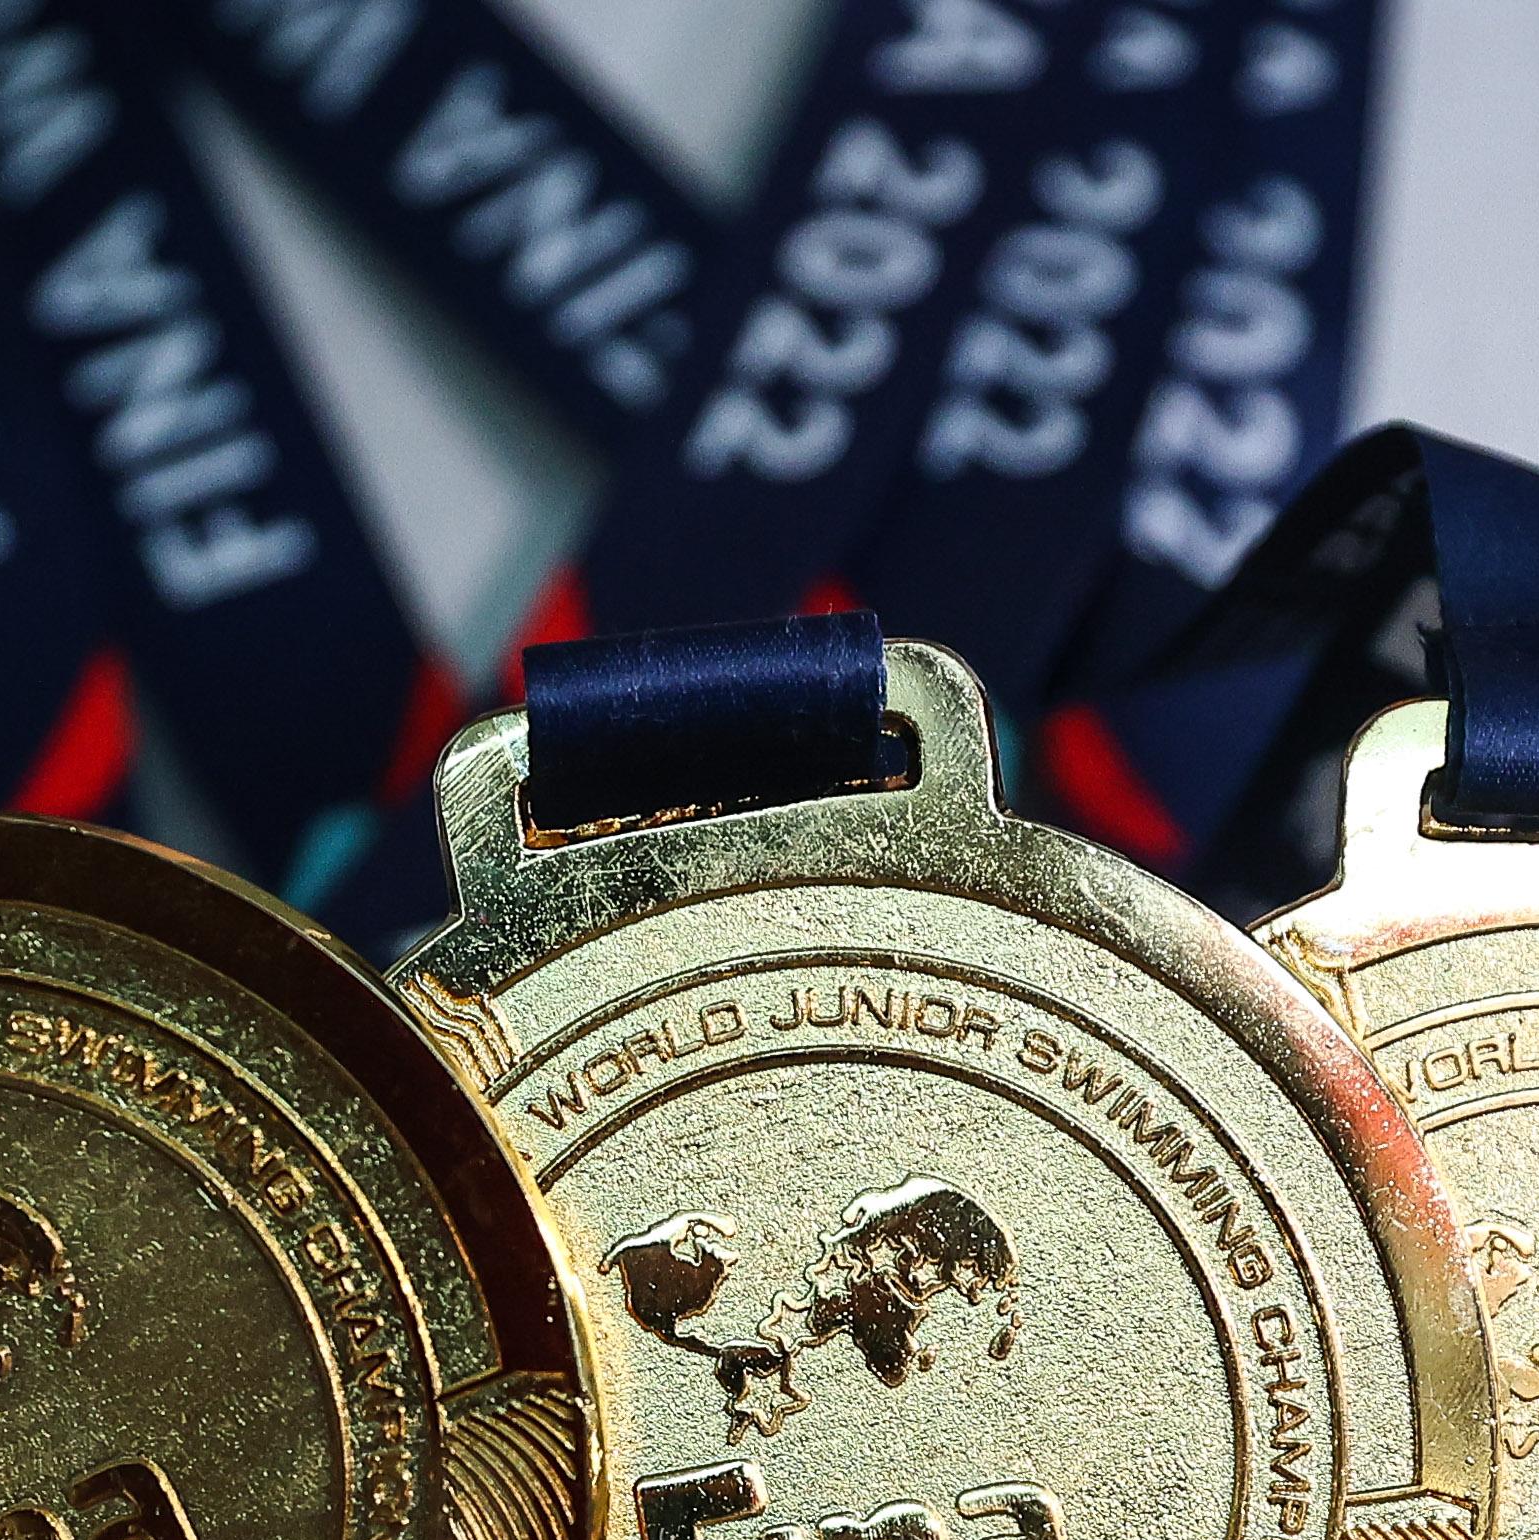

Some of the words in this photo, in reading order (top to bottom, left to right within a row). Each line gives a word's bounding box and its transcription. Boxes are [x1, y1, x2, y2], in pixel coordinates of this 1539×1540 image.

[26, 190, 321, 608] FINA
[679, 116, 987, 486] 2022
[8, 1008, 316, 1218] SWIMMING
[527, 999, 747, 1130] WORLD
[770, 986, 1001, 1052] JUNIOR
[1017, 1029, 1276, 1290] SWIMMING
